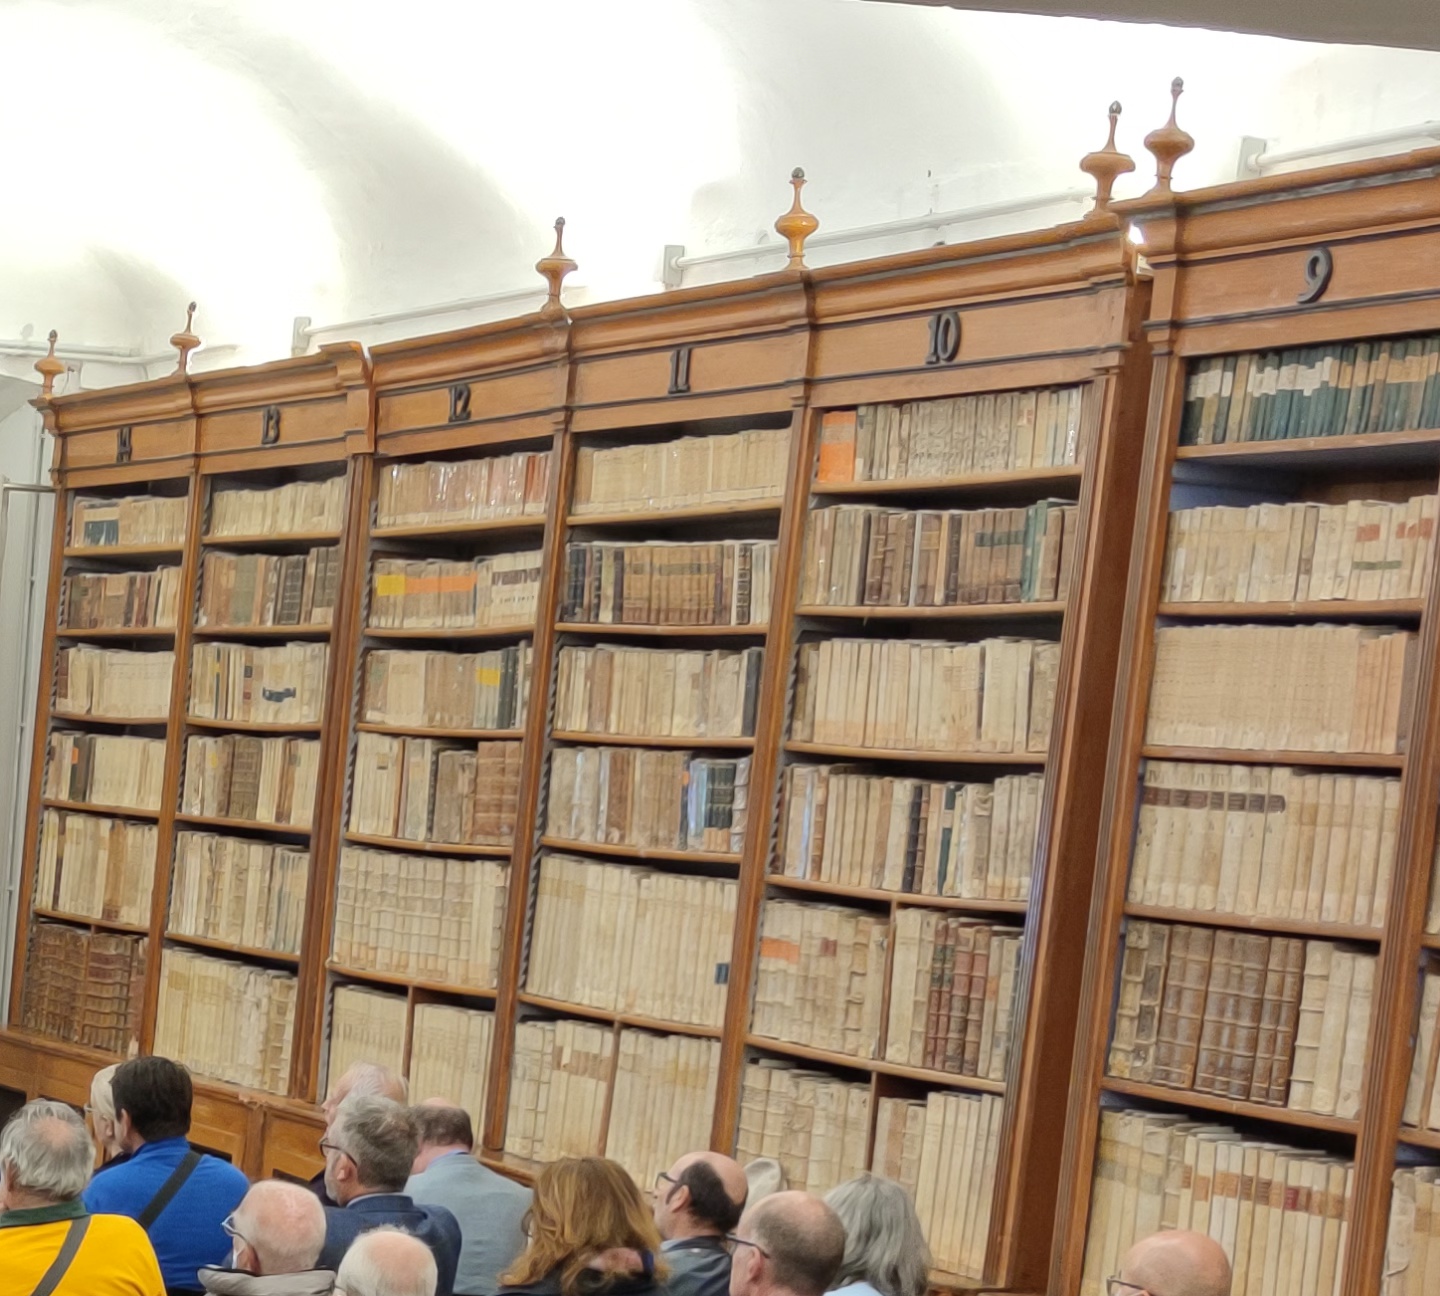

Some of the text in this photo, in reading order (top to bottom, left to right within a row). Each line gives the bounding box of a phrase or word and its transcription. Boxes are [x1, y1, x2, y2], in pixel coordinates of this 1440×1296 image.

[1298, 246, 1334, 303] 9
[926, 311, 962, 364] 10
[668, 348, 692, 394] 11
[261, 405, 280, 445] 13
[449, 383, 472, 423] 12
